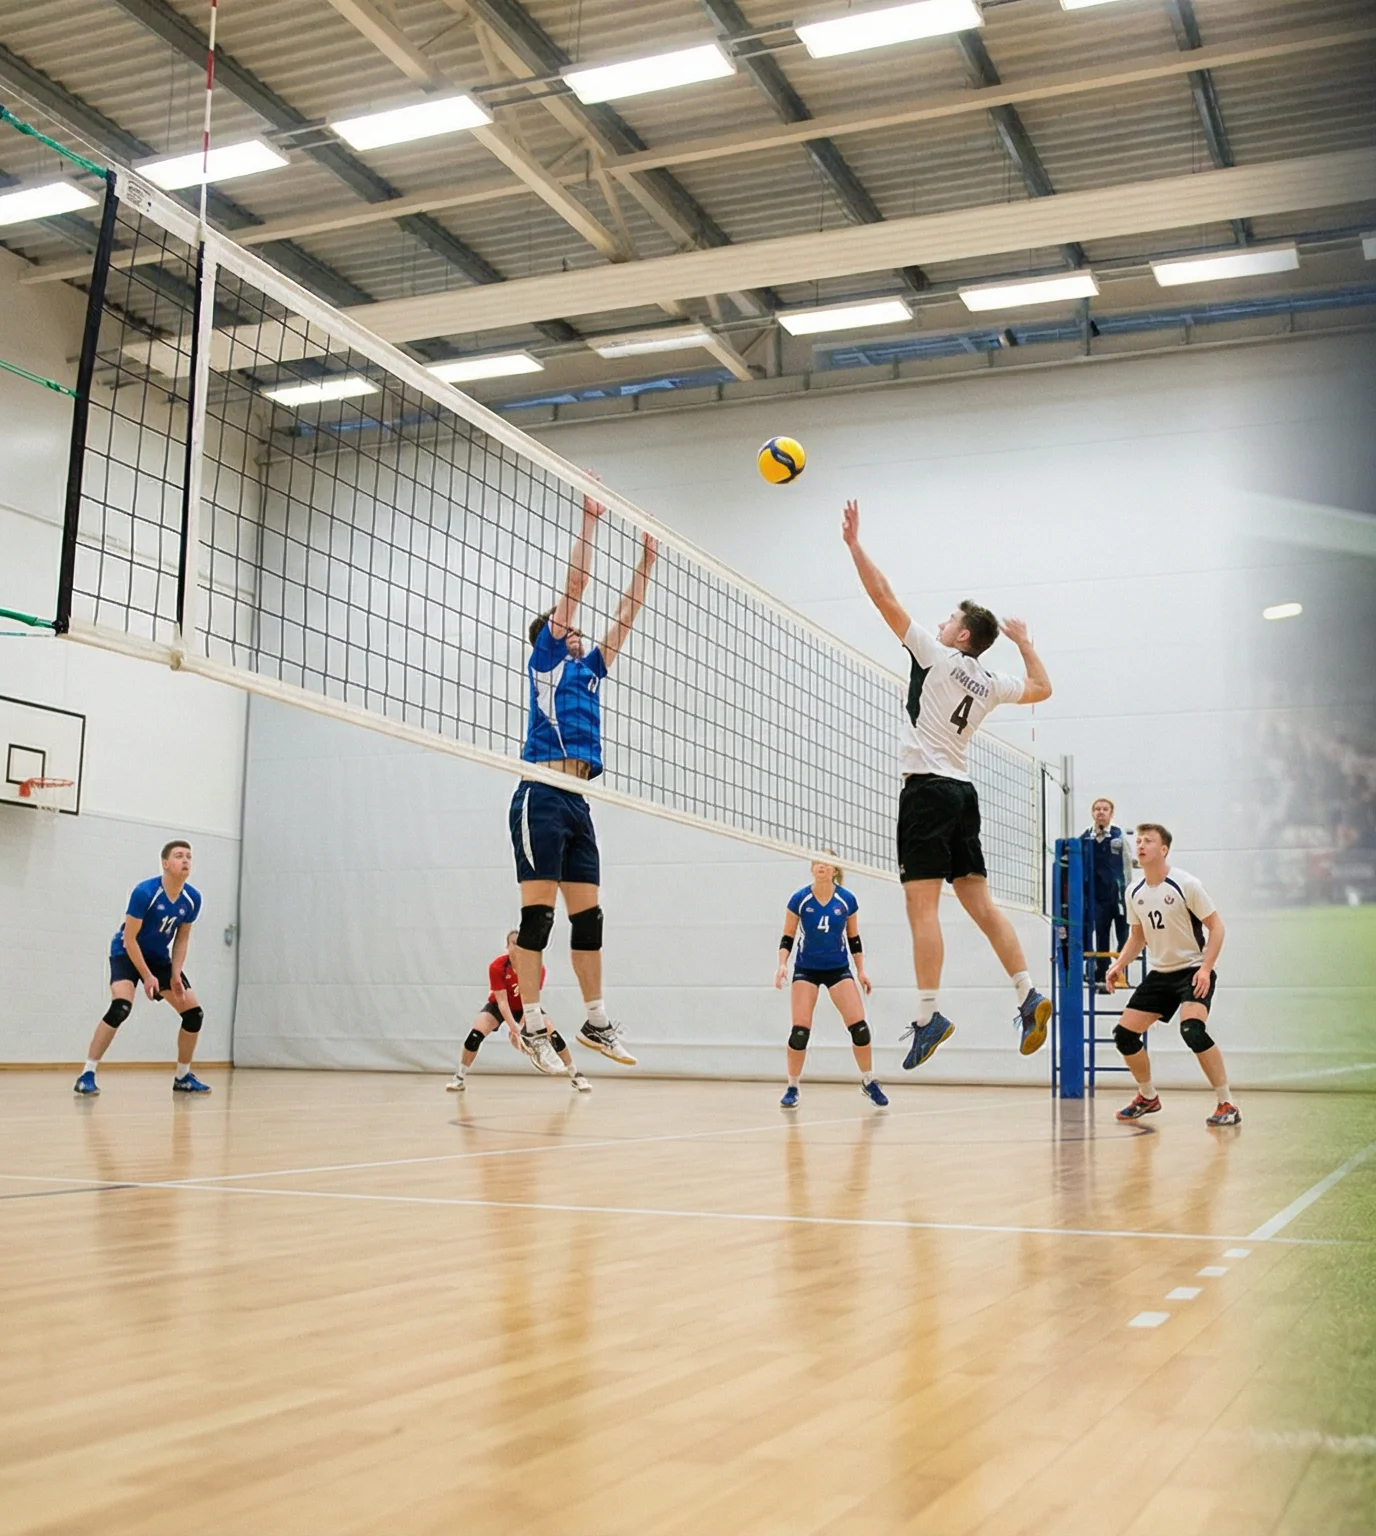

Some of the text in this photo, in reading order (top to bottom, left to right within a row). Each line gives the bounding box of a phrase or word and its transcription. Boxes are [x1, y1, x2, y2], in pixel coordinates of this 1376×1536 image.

[950, 694, 974, 735] 4
[817, 915, 830, 933] 4
[1148, 910, 1165, 930] 12
